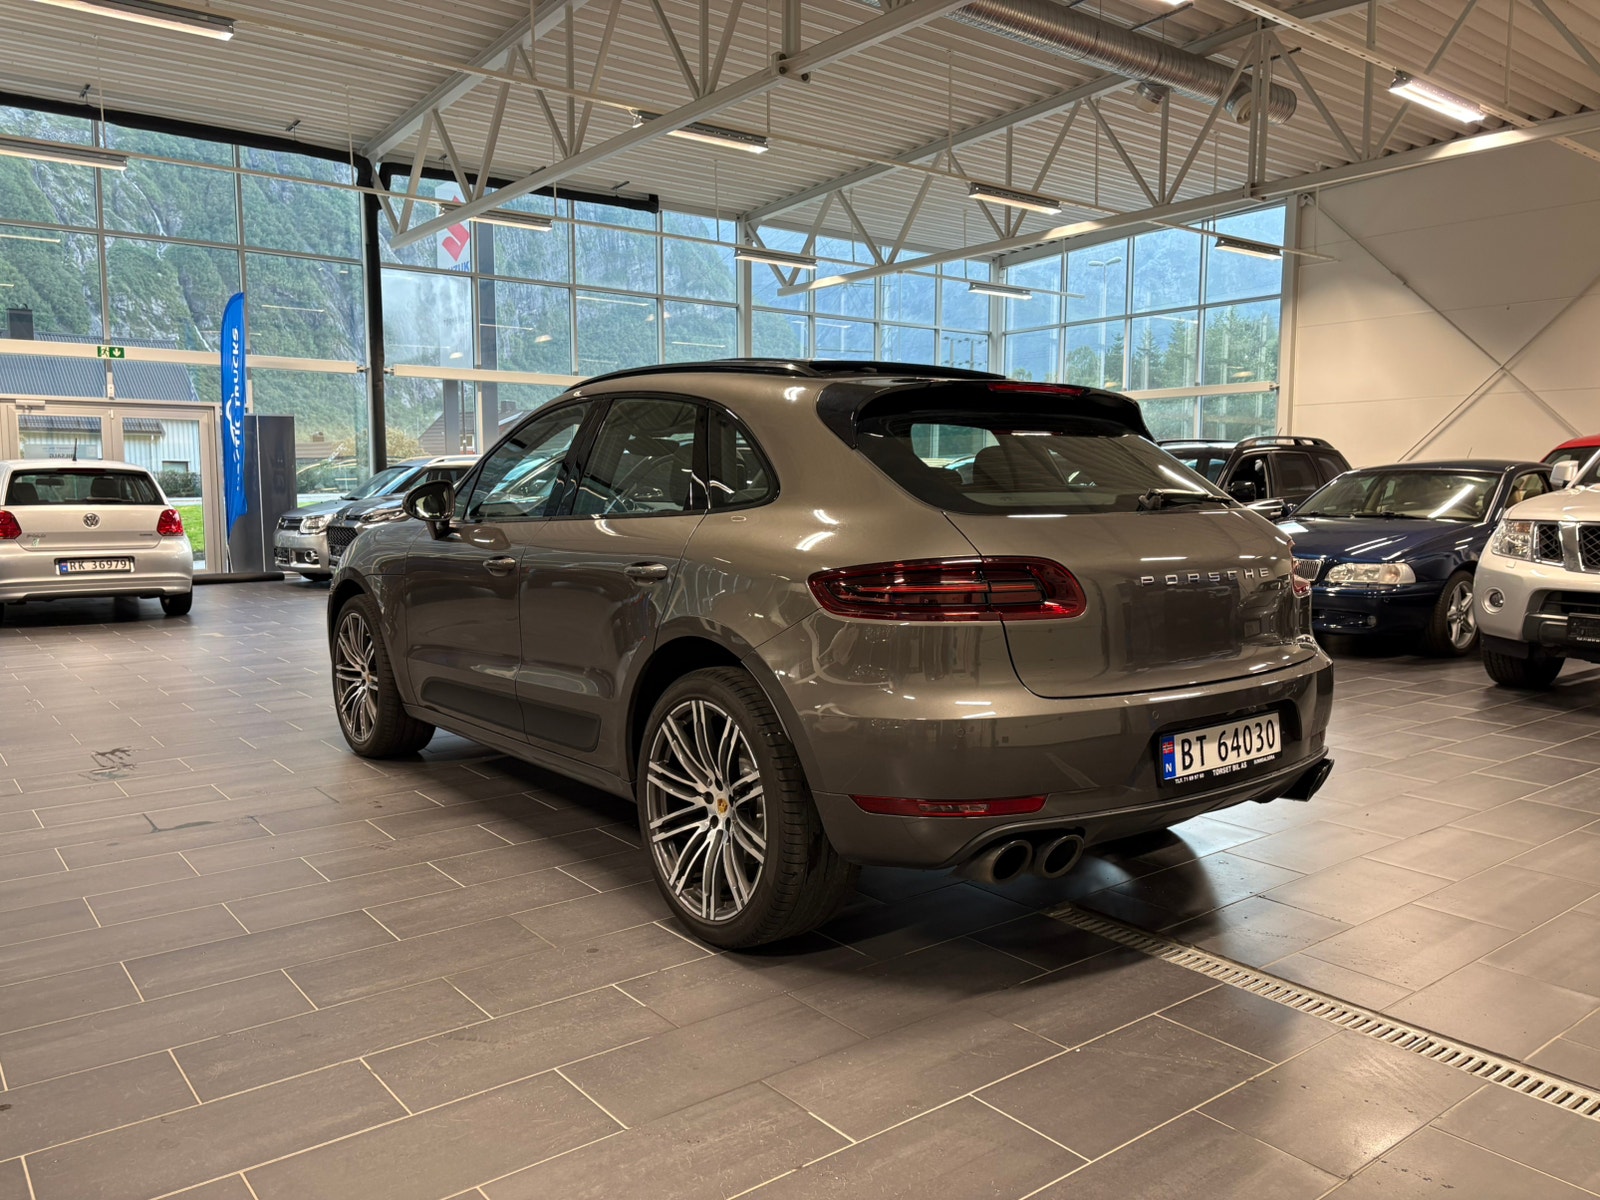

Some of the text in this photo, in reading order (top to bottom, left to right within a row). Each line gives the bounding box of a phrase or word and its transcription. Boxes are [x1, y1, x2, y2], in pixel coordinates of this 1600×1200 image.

[69, 560, 86, 570] RK
[92, 559, 127, 570] 36979
[1140, 567, 1270, 587] PORSCHE
[1181, 719, 1275, 771] BT 64030
[1165, 762, 1173, 773] N
[1232, 763, 1240, 771] BIL
[1240, 761, 1247, 769] AS
